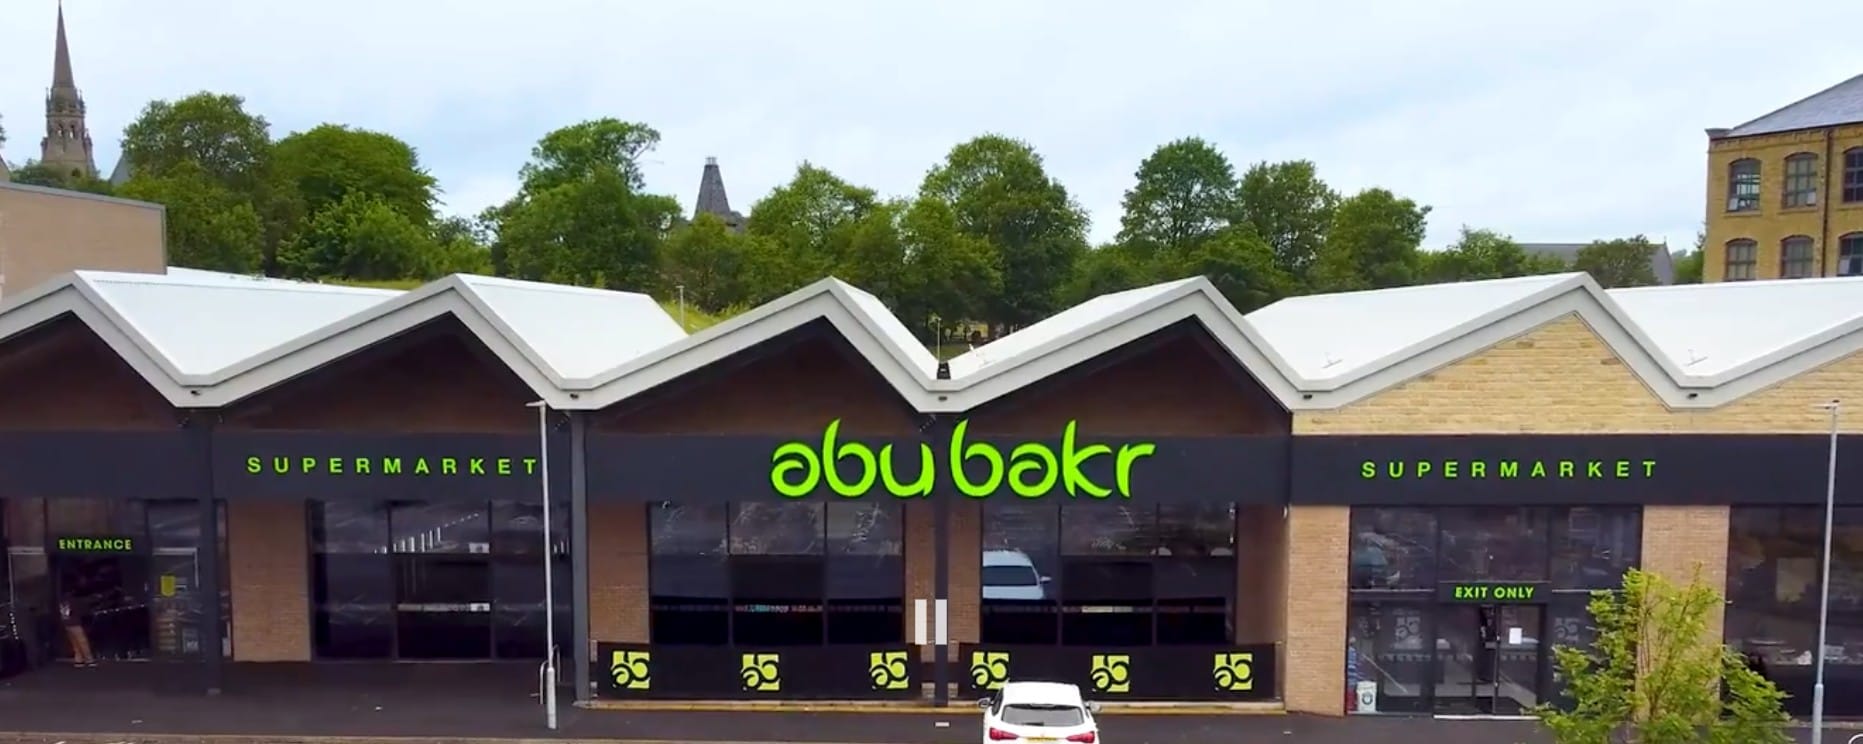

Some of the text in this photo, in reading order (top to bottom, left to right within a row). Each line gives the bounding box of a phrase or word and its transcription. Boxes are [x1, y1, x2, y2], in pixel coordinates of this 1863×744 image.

[246, 456, 537, 476] SUPERMARKET
[770, 418, 1157, 498] abu bakr
[1361, 460, 1658, 479] SUPERMARKET
[58, 538, 133, 551] ENTRANCE
[1454, 585, 1535, 599] EXIT ONLY
